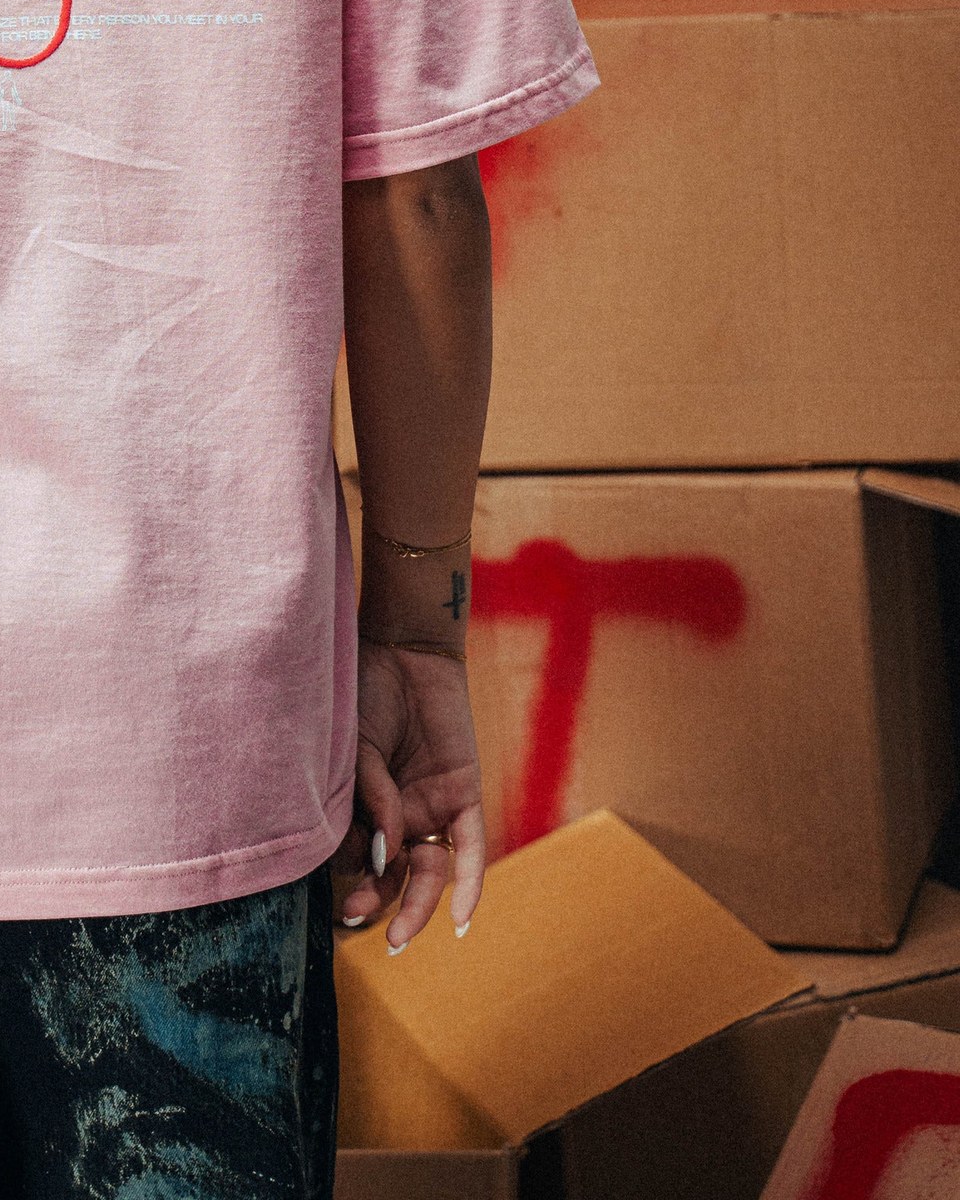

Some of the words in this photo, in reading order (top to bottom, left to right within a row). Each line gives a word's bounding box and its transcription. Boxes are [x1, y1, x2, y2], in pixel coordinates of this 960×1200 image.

[19, 15, 52, 26] THAT
[53, 14, 96, 26] EERY
[98, 14, 150, 25] PERSON
[151, 14, 178, 25] YOU
[178, 14, 214, 25] MEET
[215, 14, 229, 25] IN
[230, 12, 264, 24] YOUR
[3, 31, 28, 42] FOR
